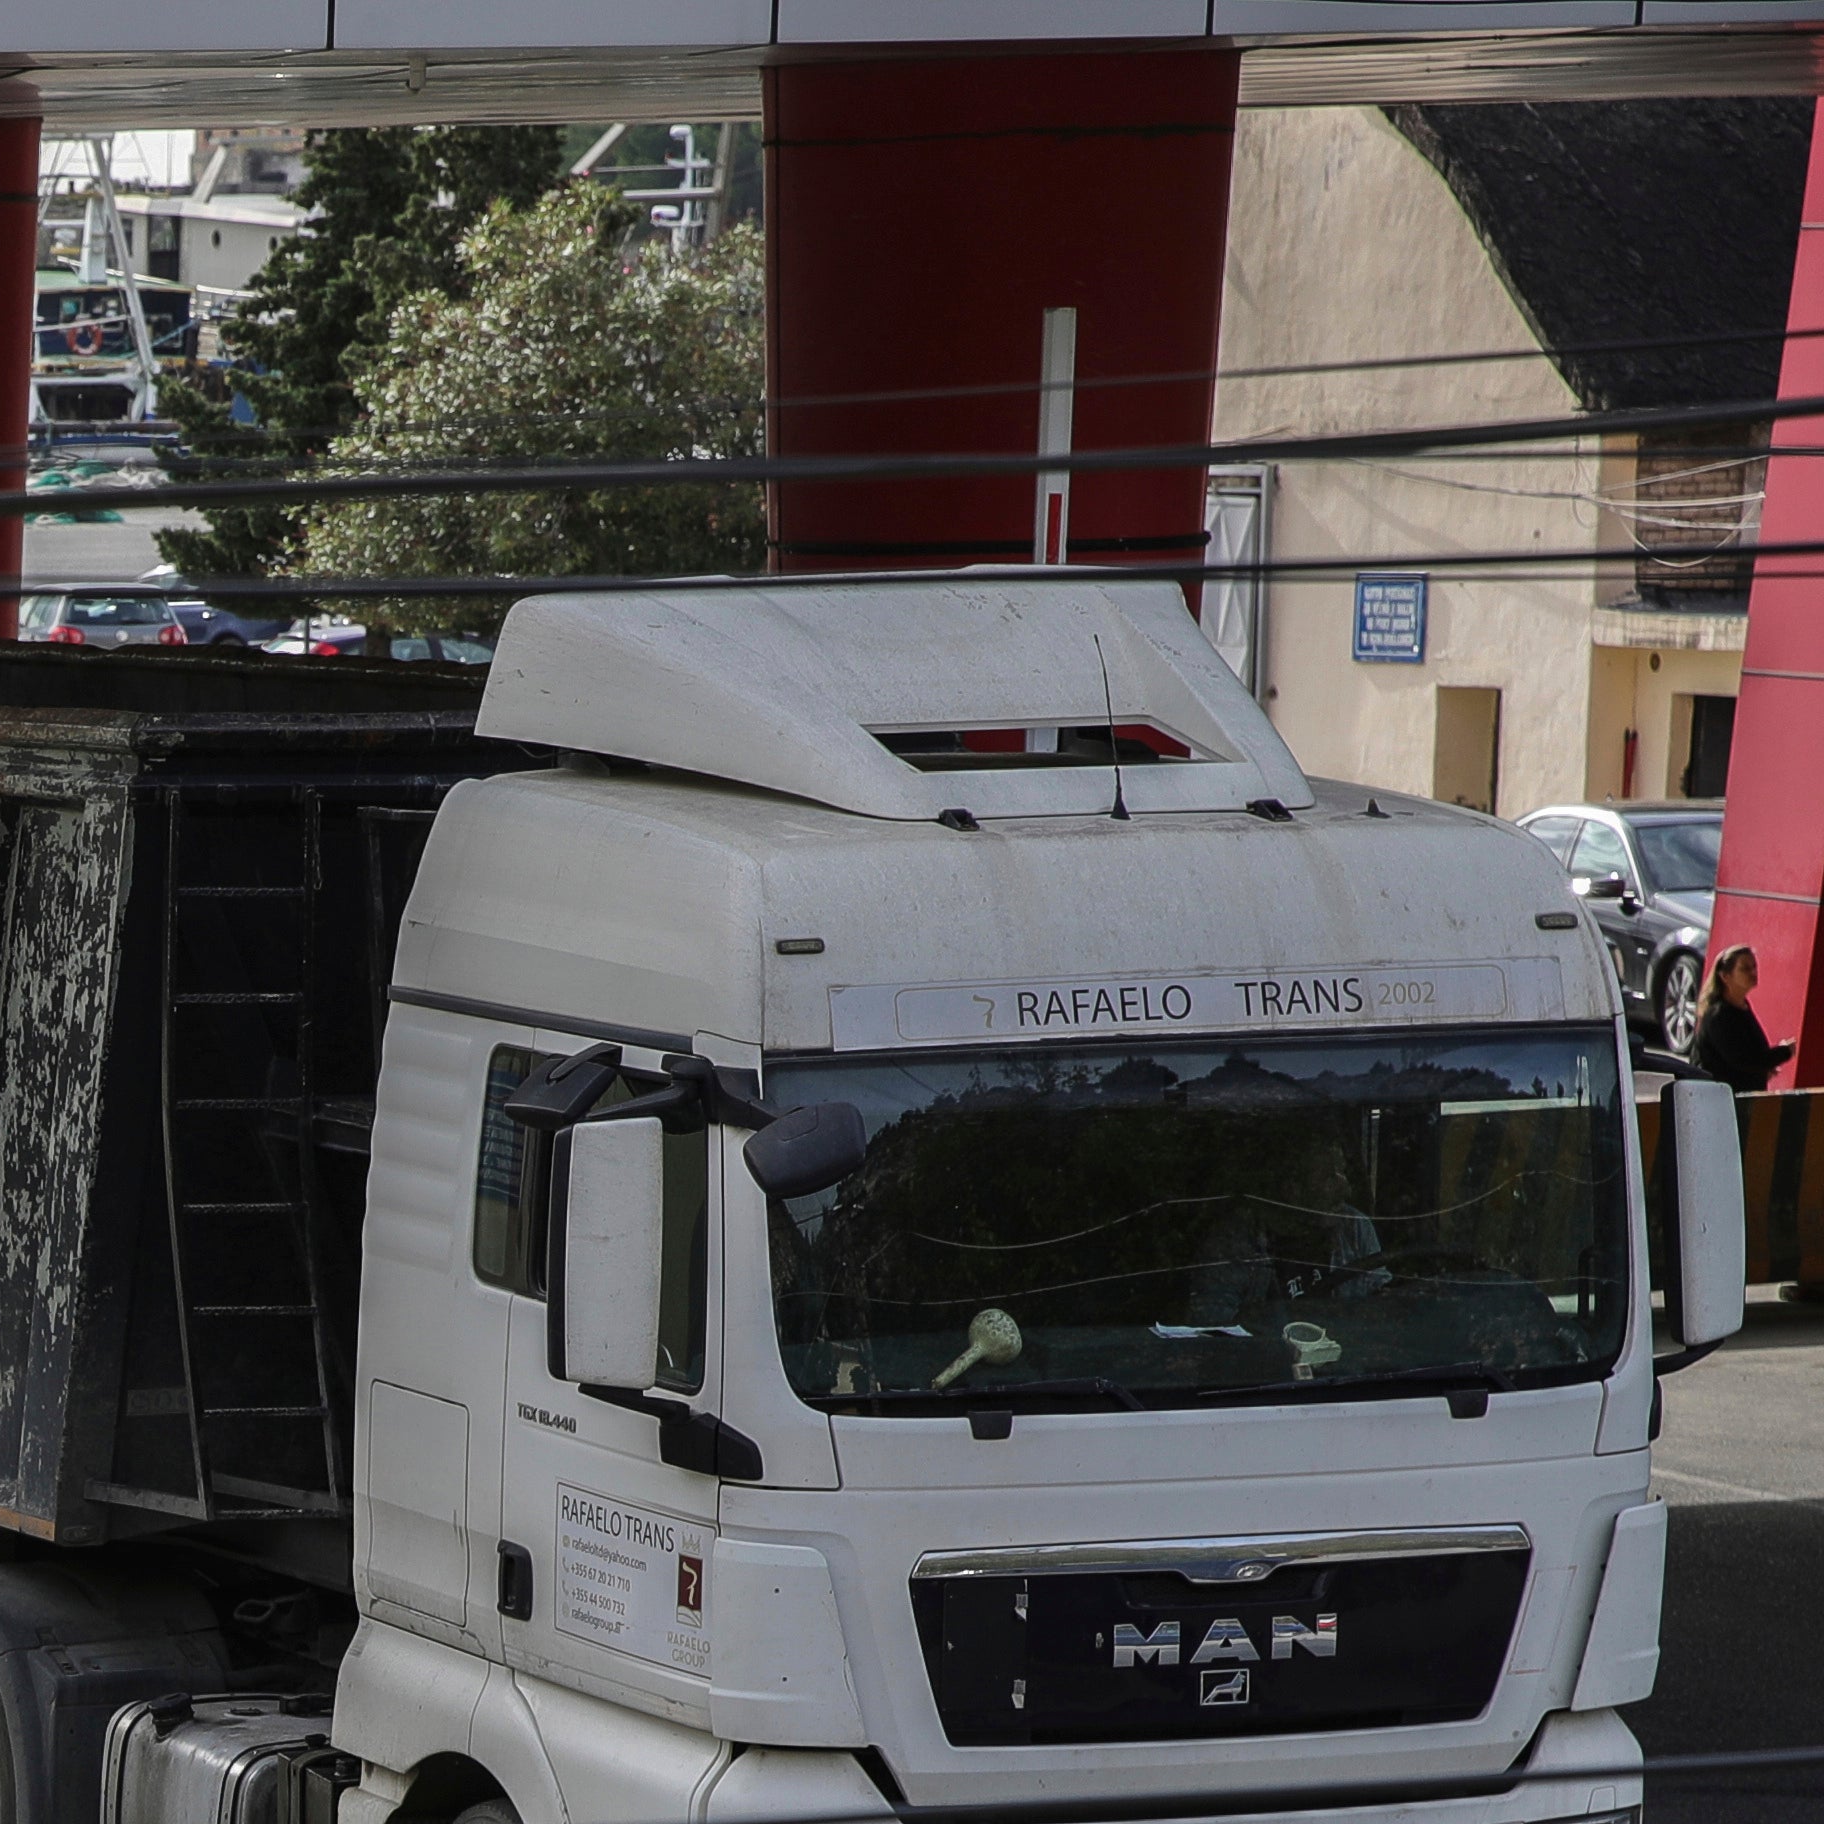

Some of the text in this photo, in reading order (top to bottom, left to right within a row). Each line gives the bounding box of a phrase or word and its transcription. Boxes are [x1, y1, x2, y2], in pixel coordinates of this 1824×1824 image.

[1015, 977, 1436, 1027] RAFAELO TRANS 2002
[561, 1494, 675, 1553] RAFAELO TRANS
[666, 1630, 711, 1654] RAFAELO
[671, 1648, 706, 1669] GROUP
[1112, 1612, 1338, 1668] MAN
